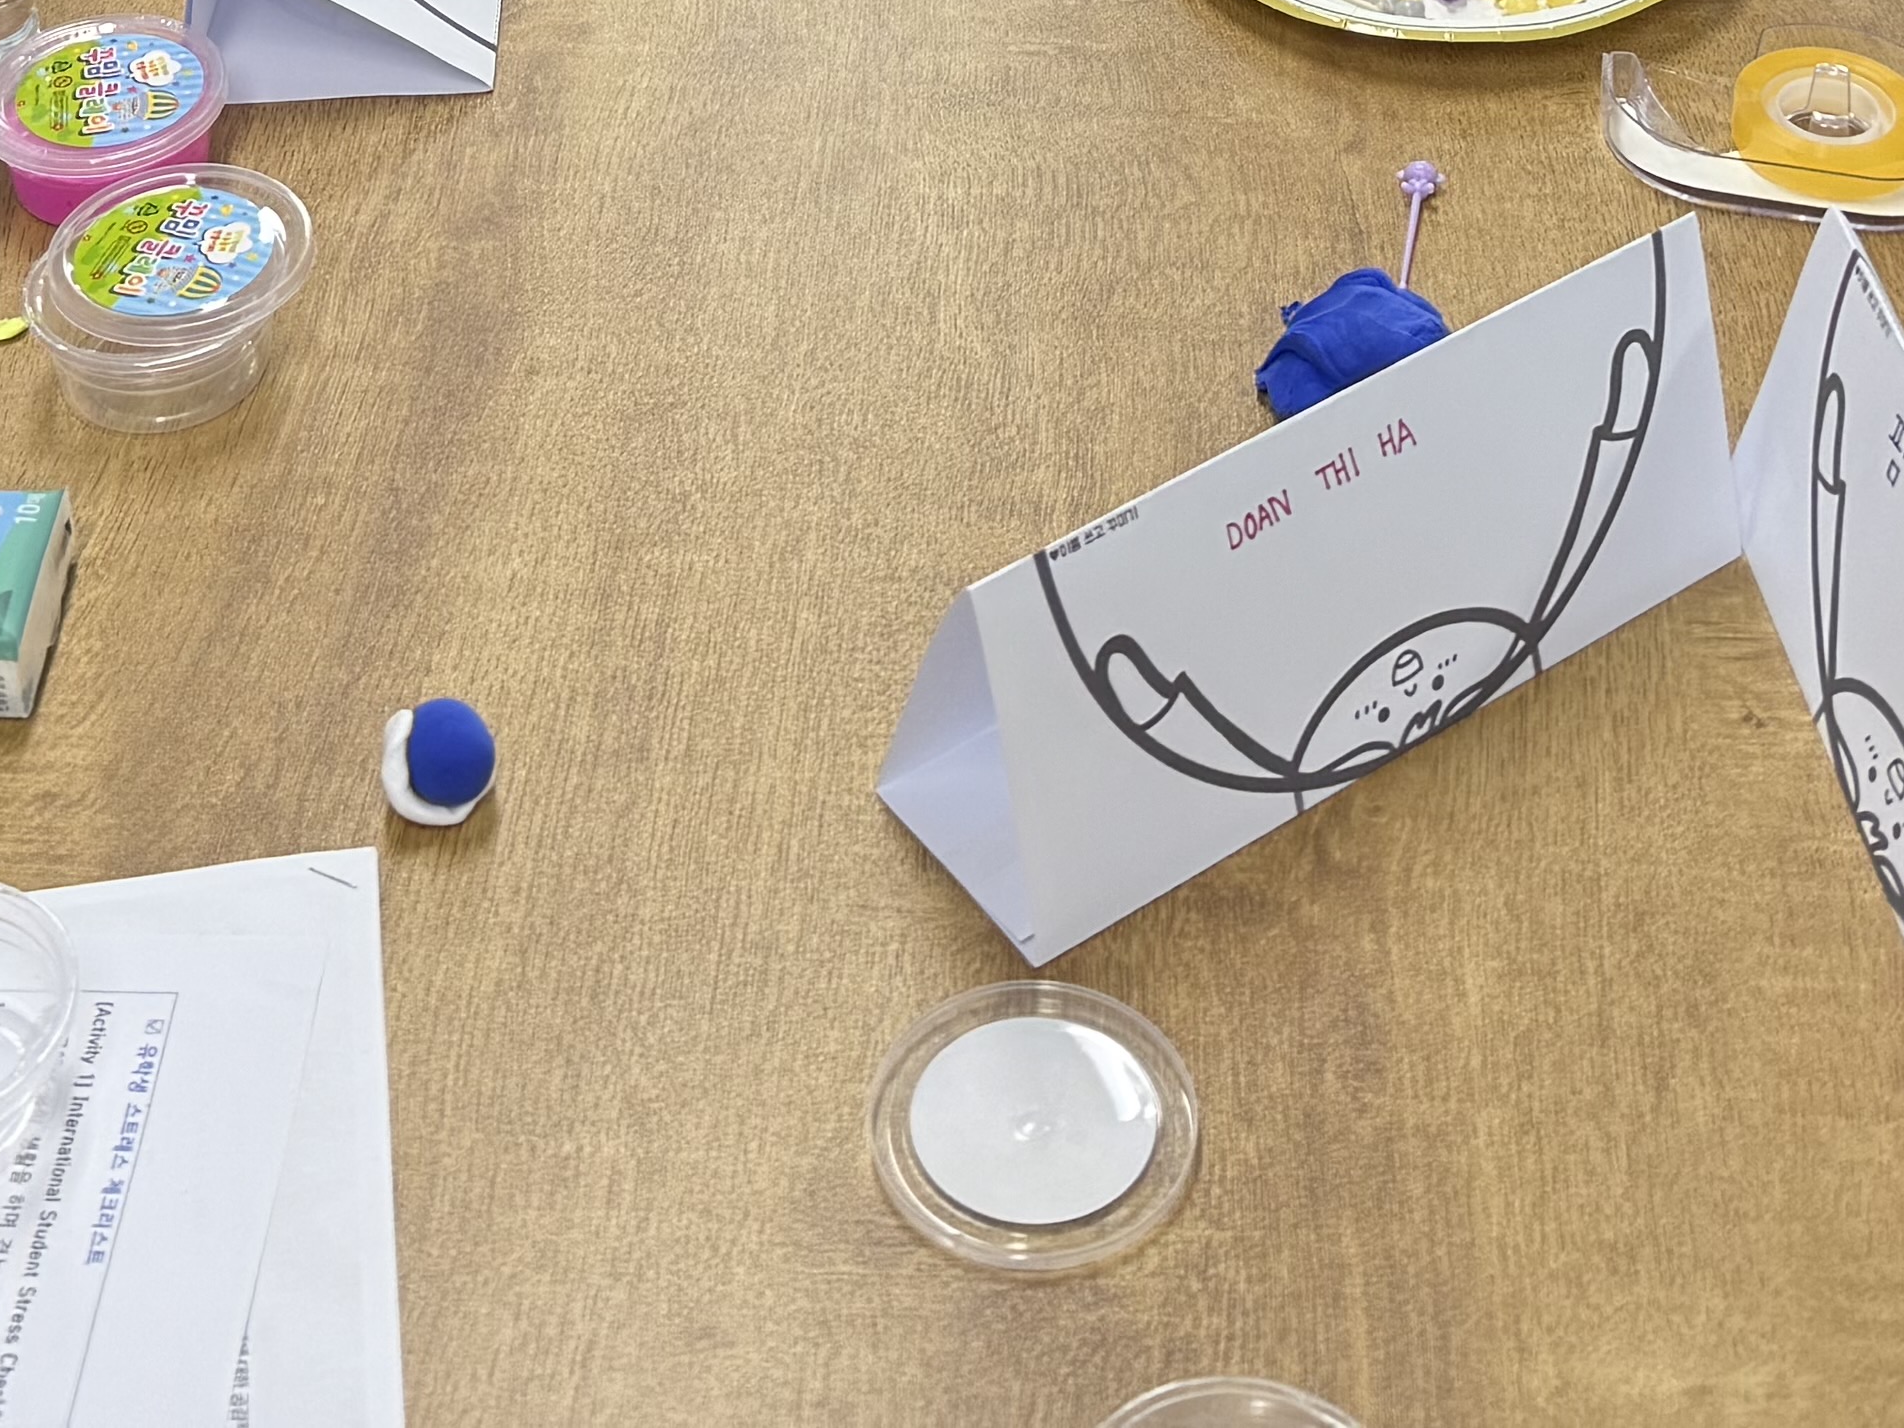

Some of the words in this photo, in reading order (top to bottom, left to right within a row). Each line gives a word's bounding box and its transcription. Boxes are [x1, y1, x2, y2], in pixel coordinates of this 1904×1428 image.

[1225, 488, 1293, 551] DOAN
[1314, 447, 1361, 491] THI
[1376, 417, 1417, 458] HA
[127, 1044, 158, 1093] 유학생
[45, 1096, 88, 1202] International
[111, 1102, 141, 1169] 스트레스
[23, 1210, 57, 1277] Student
[85, 1179, 123, 1264] 체크리스트
[5, 1286, 37, 1343] Stress
